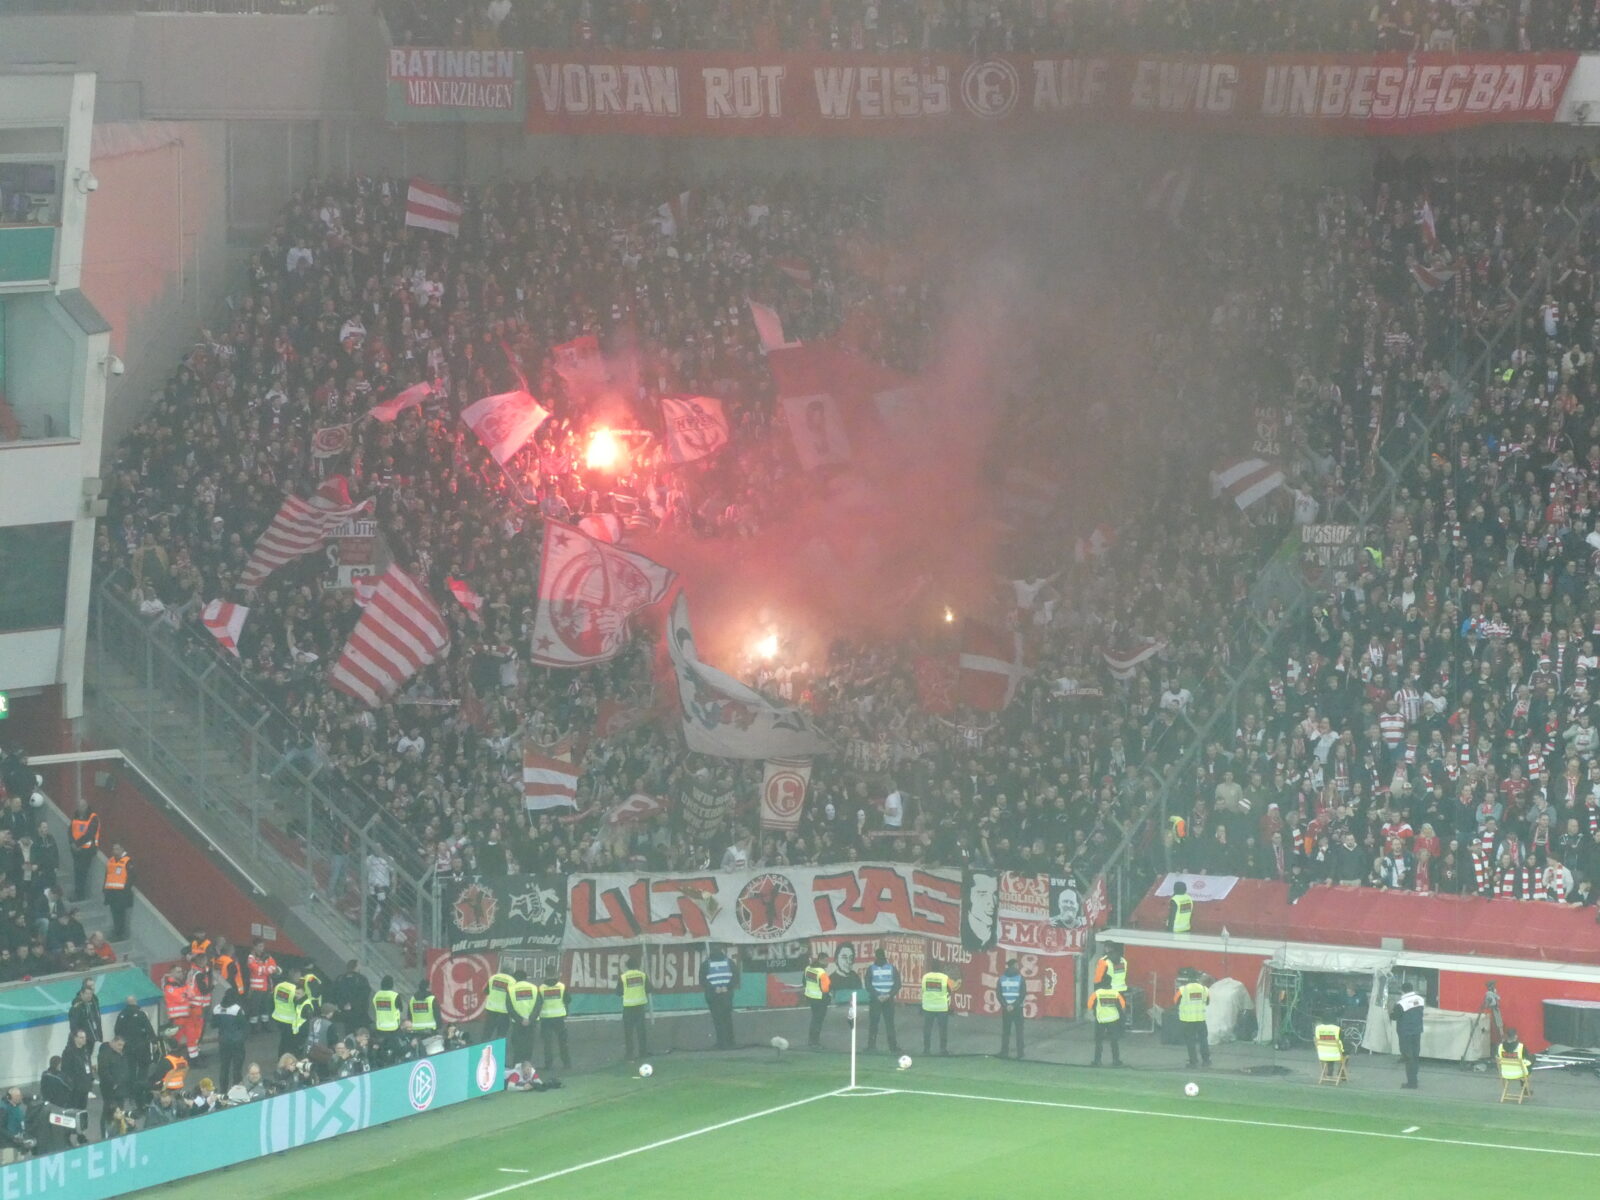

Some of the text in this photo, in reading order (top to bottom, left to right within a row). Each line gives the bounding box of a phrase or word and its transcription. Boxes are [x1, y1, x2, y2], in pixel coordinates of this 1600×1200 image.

[390, 49, 514, 78] RATINGEN
[407, 79, 513, 109] MEINERZHAGEN
[534, 63, 681, 117] VORAN
[702, 65, 786, 119] ROT
[814, 64, 951, 119] WEISS
[1130, 60, 1239, 114] EWIG
[1263, 63, 1567, 119] UNBESIEGBAR
